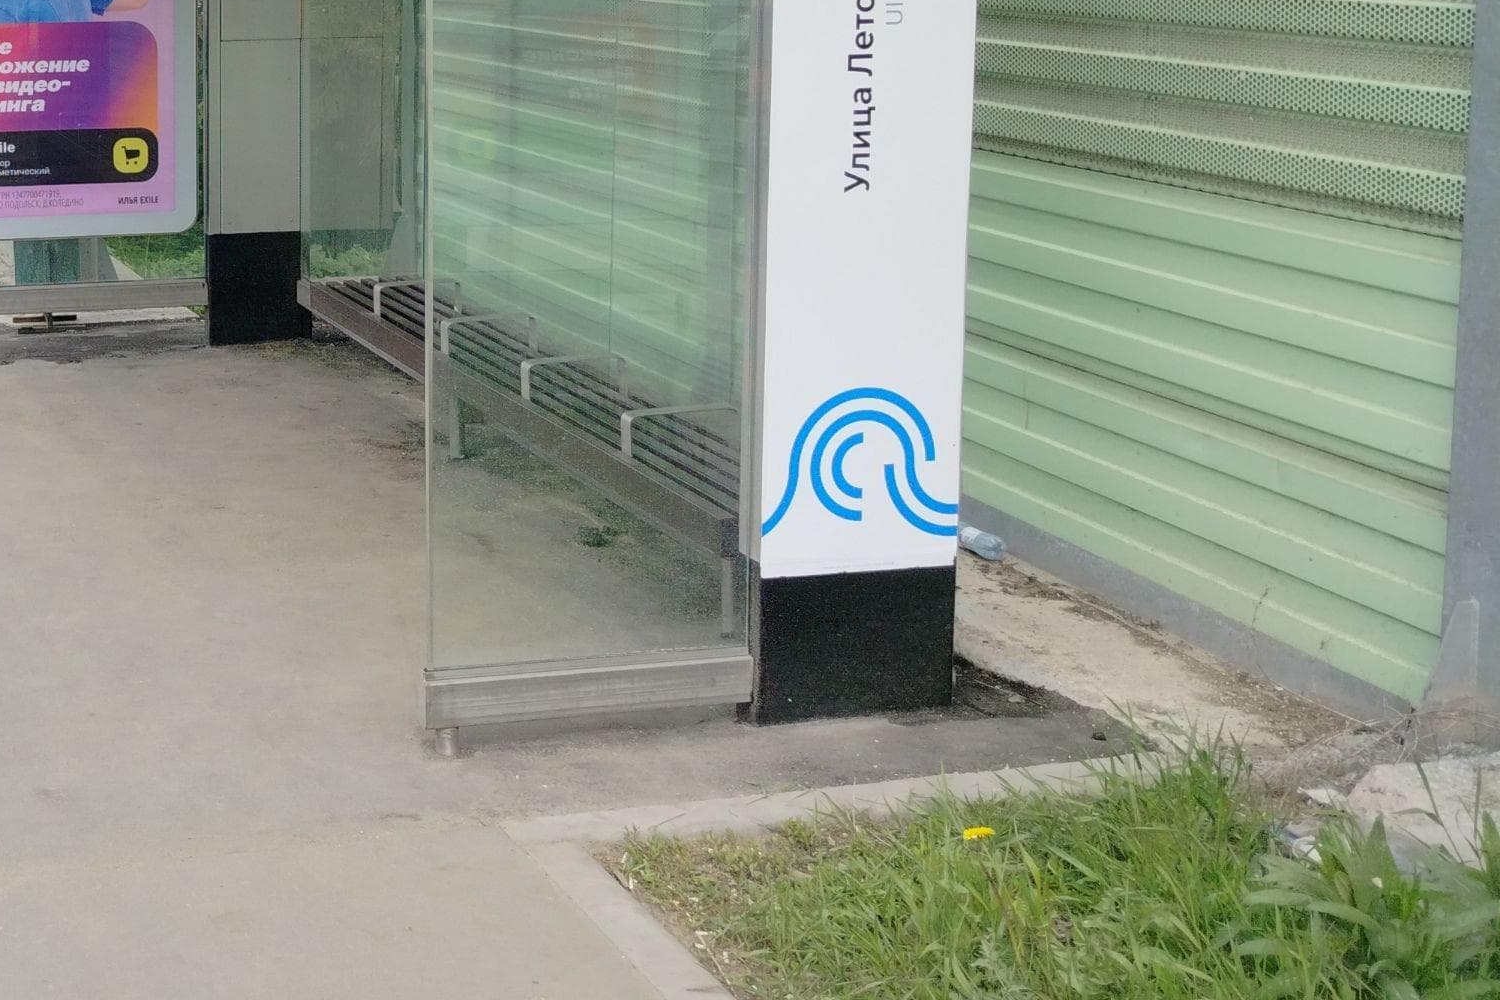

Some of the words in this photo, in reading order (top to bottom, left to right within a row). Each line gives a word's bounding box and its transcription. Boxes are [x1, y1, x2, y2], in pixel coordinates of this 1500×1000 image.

[843, 87, 876, 194] Улица
[117, 196, 138, 205] ИЛЬЯ
[140, 195, 159, 204] EXILE
